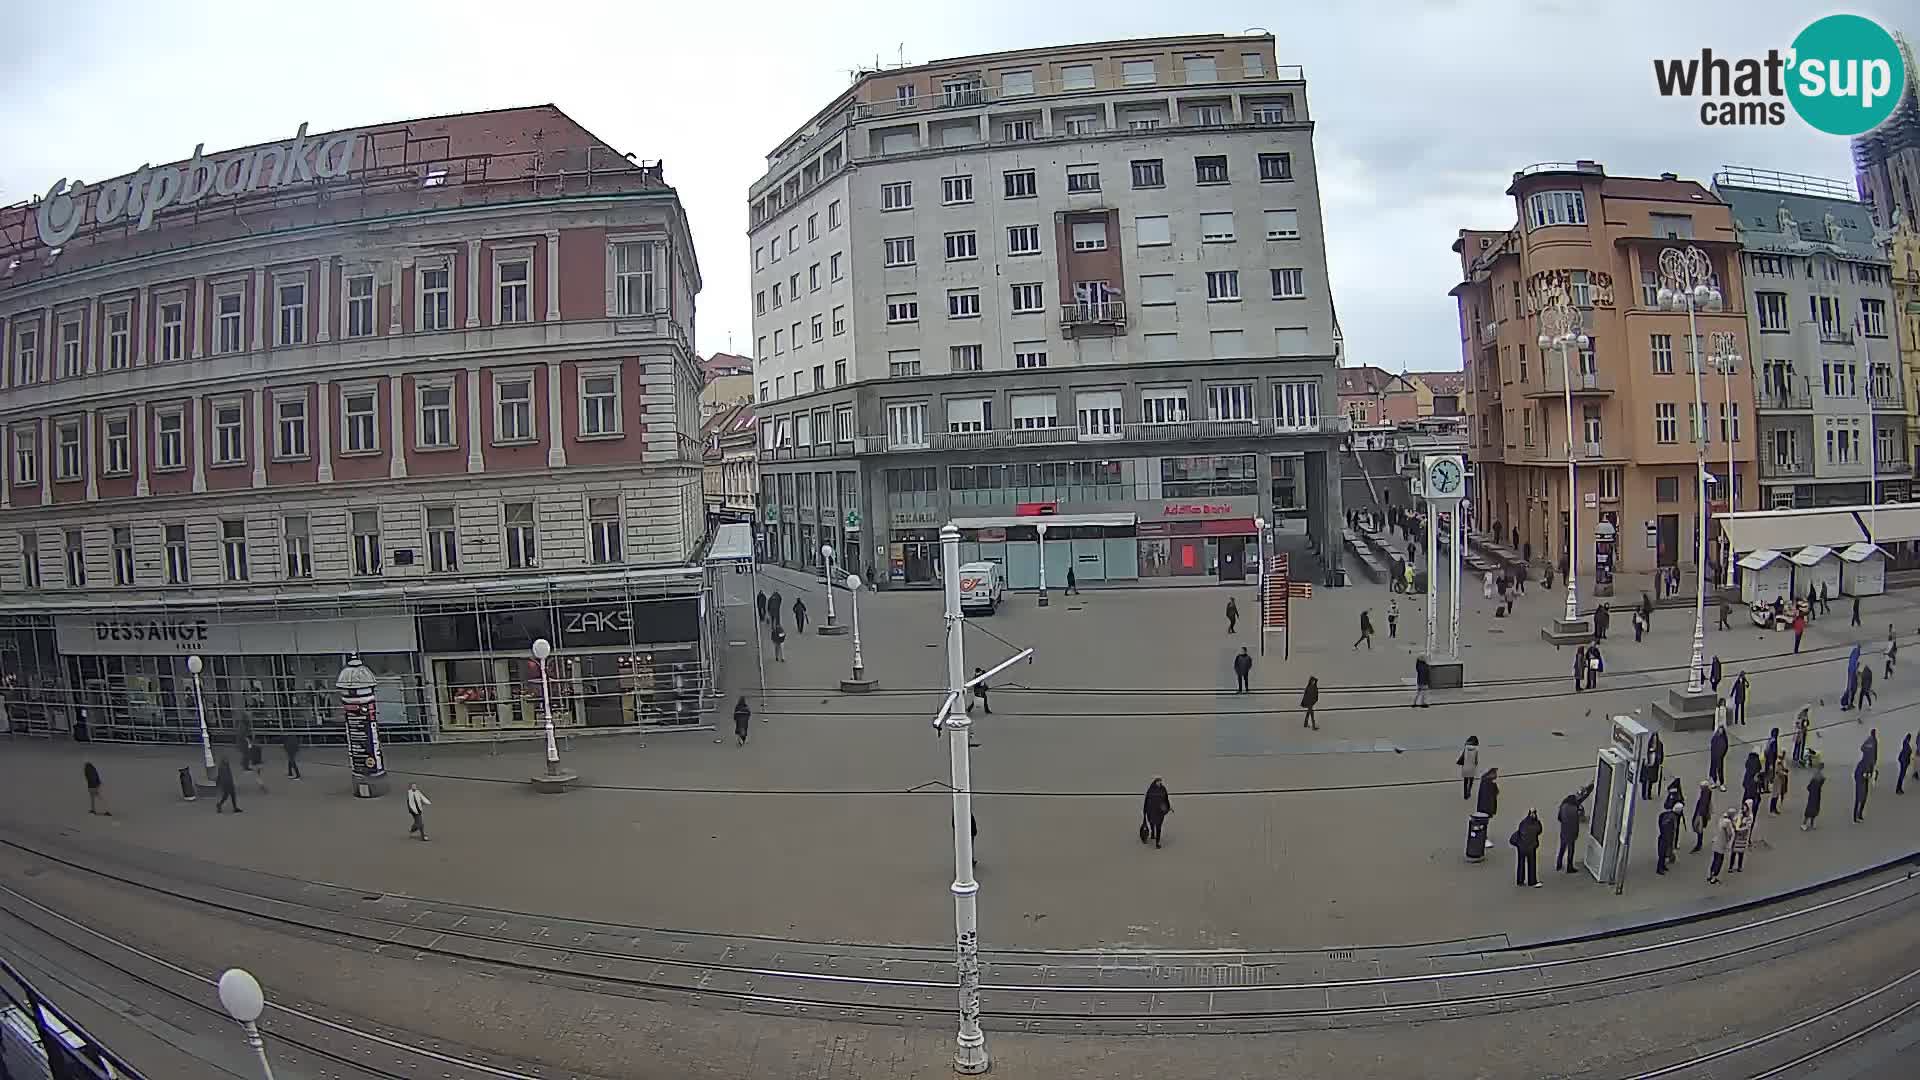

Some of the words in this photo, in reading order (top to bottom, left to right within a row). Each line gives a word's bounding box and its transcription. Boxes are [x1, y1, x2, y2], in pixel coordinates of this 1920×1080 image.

[96, 162, 178, 231] otp
[180, 121, 356, 203] banka
[96, 620, 208, 641] DESSANGE
[564, 610, 635, 633] ZAKS
